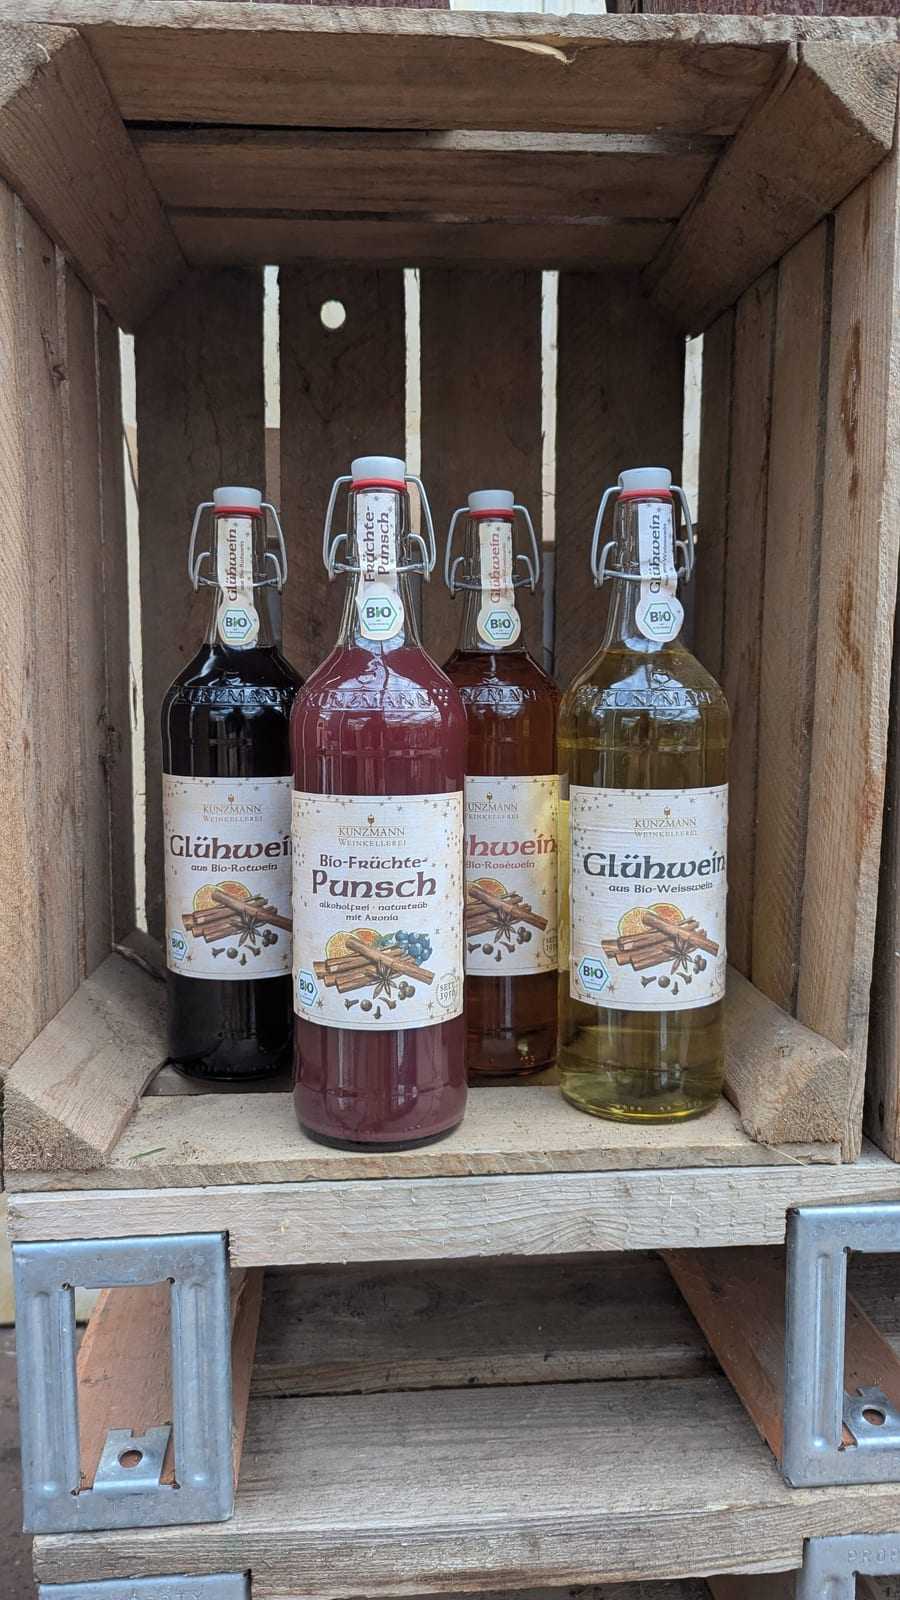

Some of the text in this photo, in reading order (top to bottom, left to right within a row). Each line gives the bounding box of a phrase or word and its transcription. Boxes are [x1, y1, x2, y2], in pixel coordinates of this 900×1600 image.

[377, 512, 390, 576] Punsch
[649, 514, 661, 594] Glühwein
[225, 527, 238, 602] Glühwein
[203, 803, 261, 815] KUNZMANN
[634, 817, 697, 828] KUNZMANN
[338, 826, 405, 837] KUNZMANN
[338, 838, 406, 847] WEINKELLEREI
[191, 864, 208, 872] aus
[583, 850, 725, 879] Glühwein
[311, 869, 437, 898] Punsch
[608, 881, 713, 894] aus Bio-Weisswein
[345, 913, 363, 921] mit
